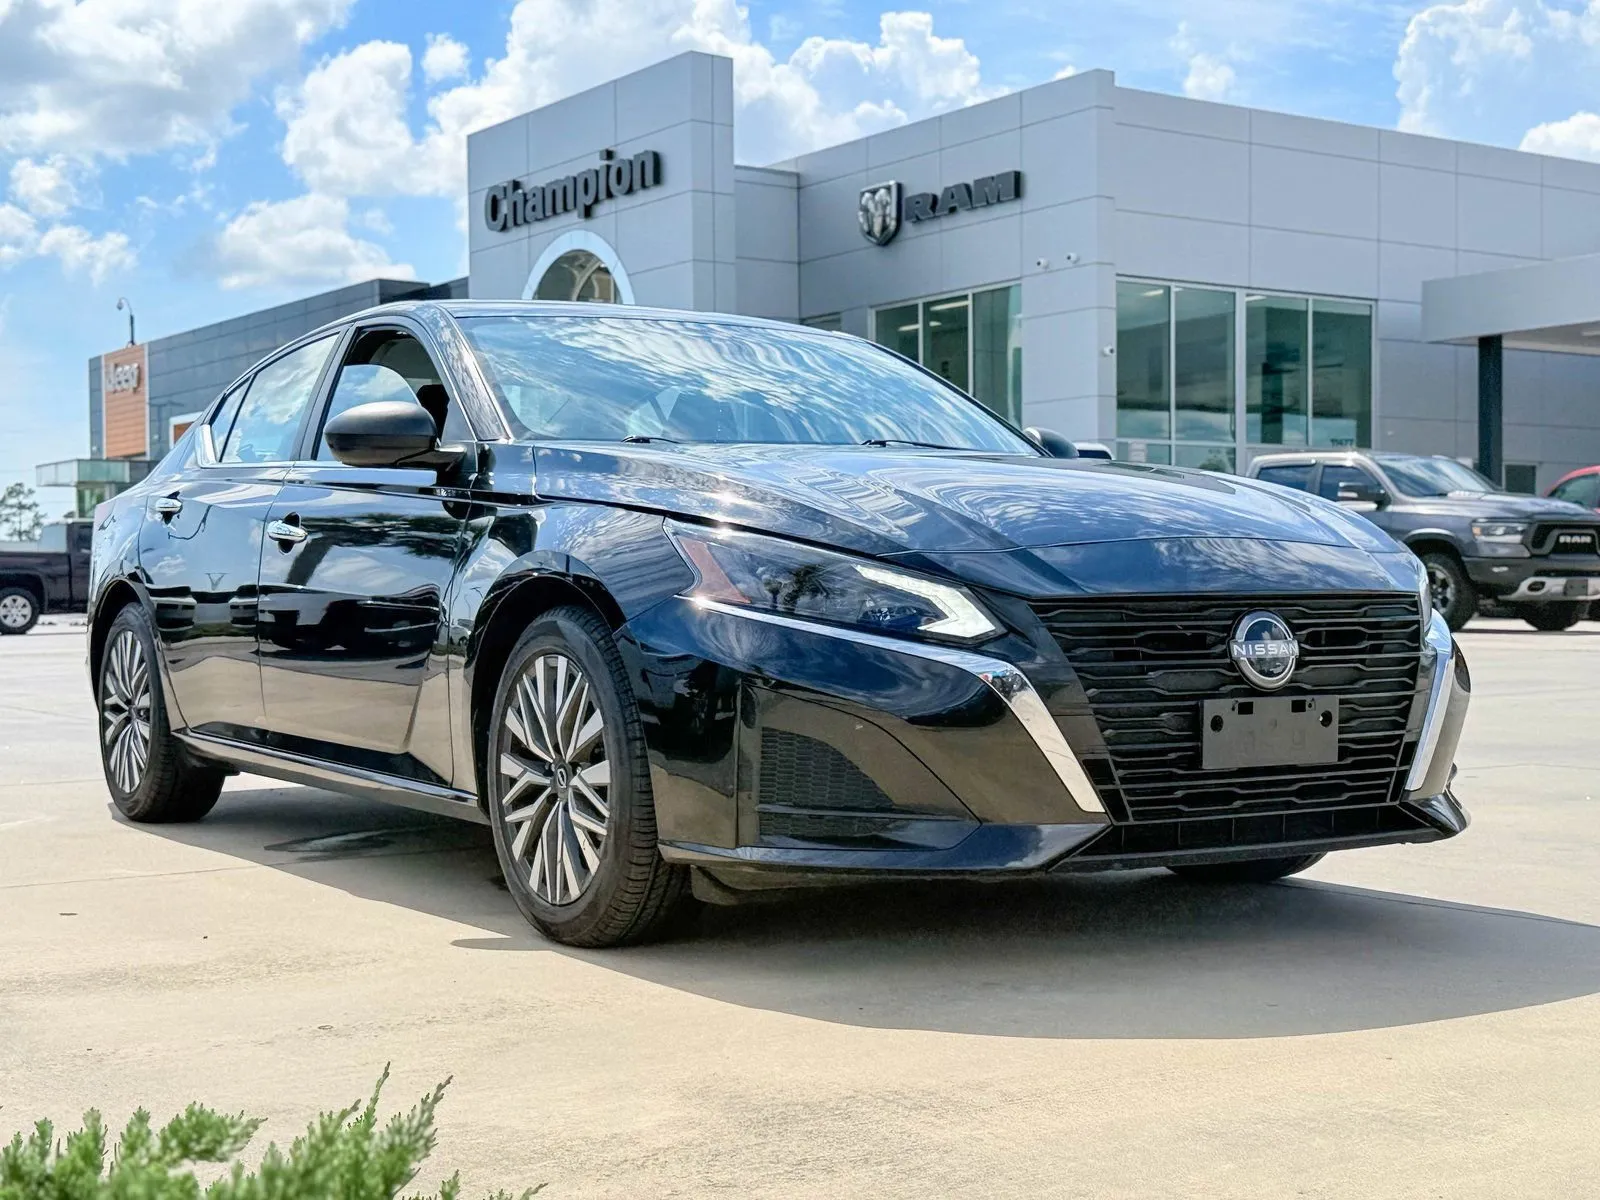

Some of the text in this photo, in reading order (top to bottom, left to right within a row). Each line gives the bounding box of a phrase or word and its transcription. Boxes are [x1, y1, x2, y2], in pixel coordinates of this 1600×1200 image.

[485, 149, 661, 232] Champion
[905, 170, 1021, 223] RAM
[107, 363, 139, 393] Jeep
[1232, 643, 1299, 656] NISSAN
